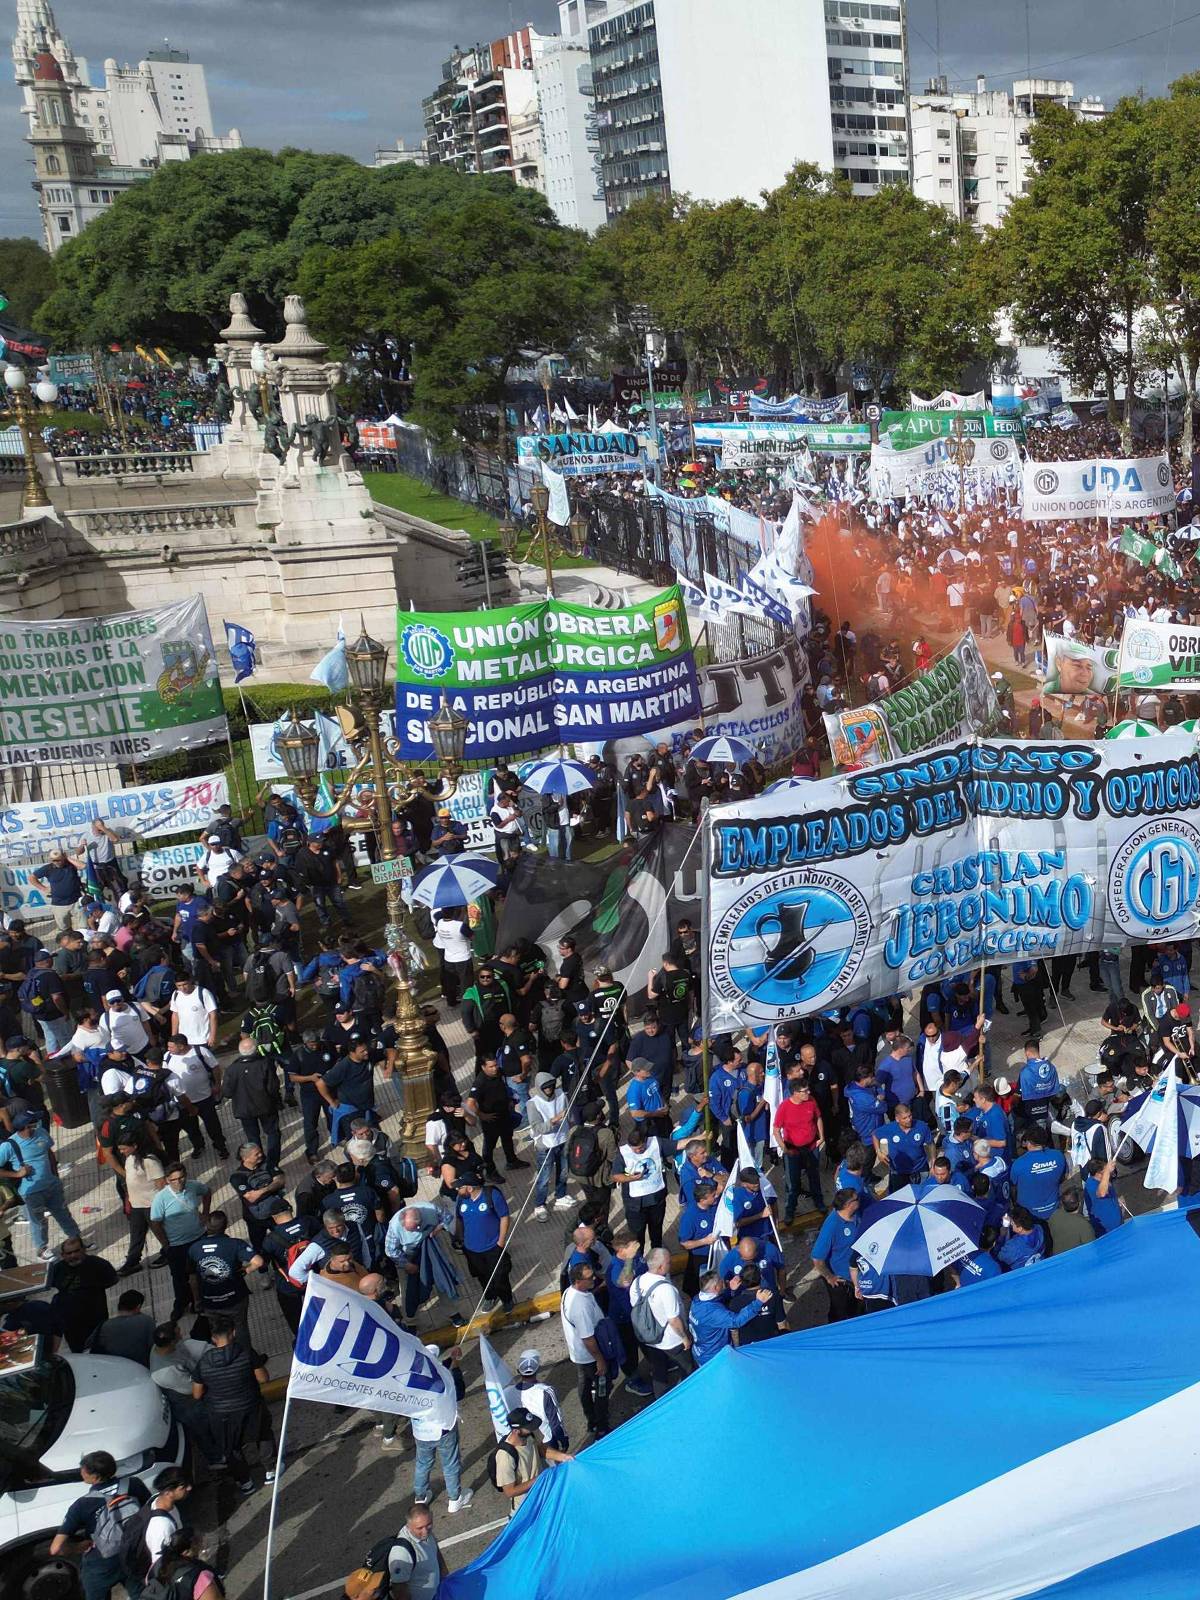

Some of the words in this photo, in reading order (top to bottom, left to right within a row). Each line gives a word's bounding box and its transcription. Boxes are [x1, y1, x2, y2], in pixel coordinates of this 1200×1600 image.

[537, 432, 639, 458] SANIDAD
[905, 417, 942, 435] APU
[950, 419, 982, 432] FDUN
[994, 419, 1022, 432] FEDUN
[598, 454, 625, 464] AIRES
[1081, 465, 1143, 493] UDA
[1032, 501, 1066, 512] UNION
[24, 618, 158, 649] TRABAJADORES
[453, 616, 540, 649] UNIÓN
[543, 611, 650, 635] OBRERA
[93, 644, 114, 662] DE
[119, 641, 141, 658] LA
[456, 639, 655, 681] METALÚRGICA
[0, 660, 146, 699] MENTACION
[406, 691, 430, 710] DE
[473, 674, 579, 712] REPÚBLICA
[584, 661, 689, 695] ARGENTINA
[2, 696, 146, 742] RESENTE
[553, 702, 603, 727] SAN
[611, 683, 693, 724] MARTÍN
[39, 742, 104, 762] BUENOS
[110, 736, 151, 756] AIRES
[854, 747, 1094, 797] SINDICATO
[34, 787, 177, 830] JUBILADXS
[719, 802, 906, 873] EMPLEADOS
[913, 789, 963, 831] DEL
[965, 780, 1063, 815] VIDRIO
[1073, 780, 1096, 814] Y
[1107, 759, 1200, 812] OPTICOS
[374, 863, 387, 874] NO
[390, 860, 407, 871] ME
[764, 882, 779, 895] DE
[782, 875, 795, 887] LA
[799, 872, 851, 899] INDUSTRIA
[911, 849, 1065, 897] CRISTIAN
[1113, 832, 1147, 924] CONFEDERACION
[1148, 822, 1189, 837] GENERAL
[884, 872, 1093, 970] JERONIMO
[908, 928, 1060, 981] CONDUCCION
[294, 1295, 446, 1395] UDA
[290, 1368, 323, 1385] UNION
[323, 1377, 374, 1397] DOCENTES
[376, 1389, 434, 1409] ARGENTINOS
